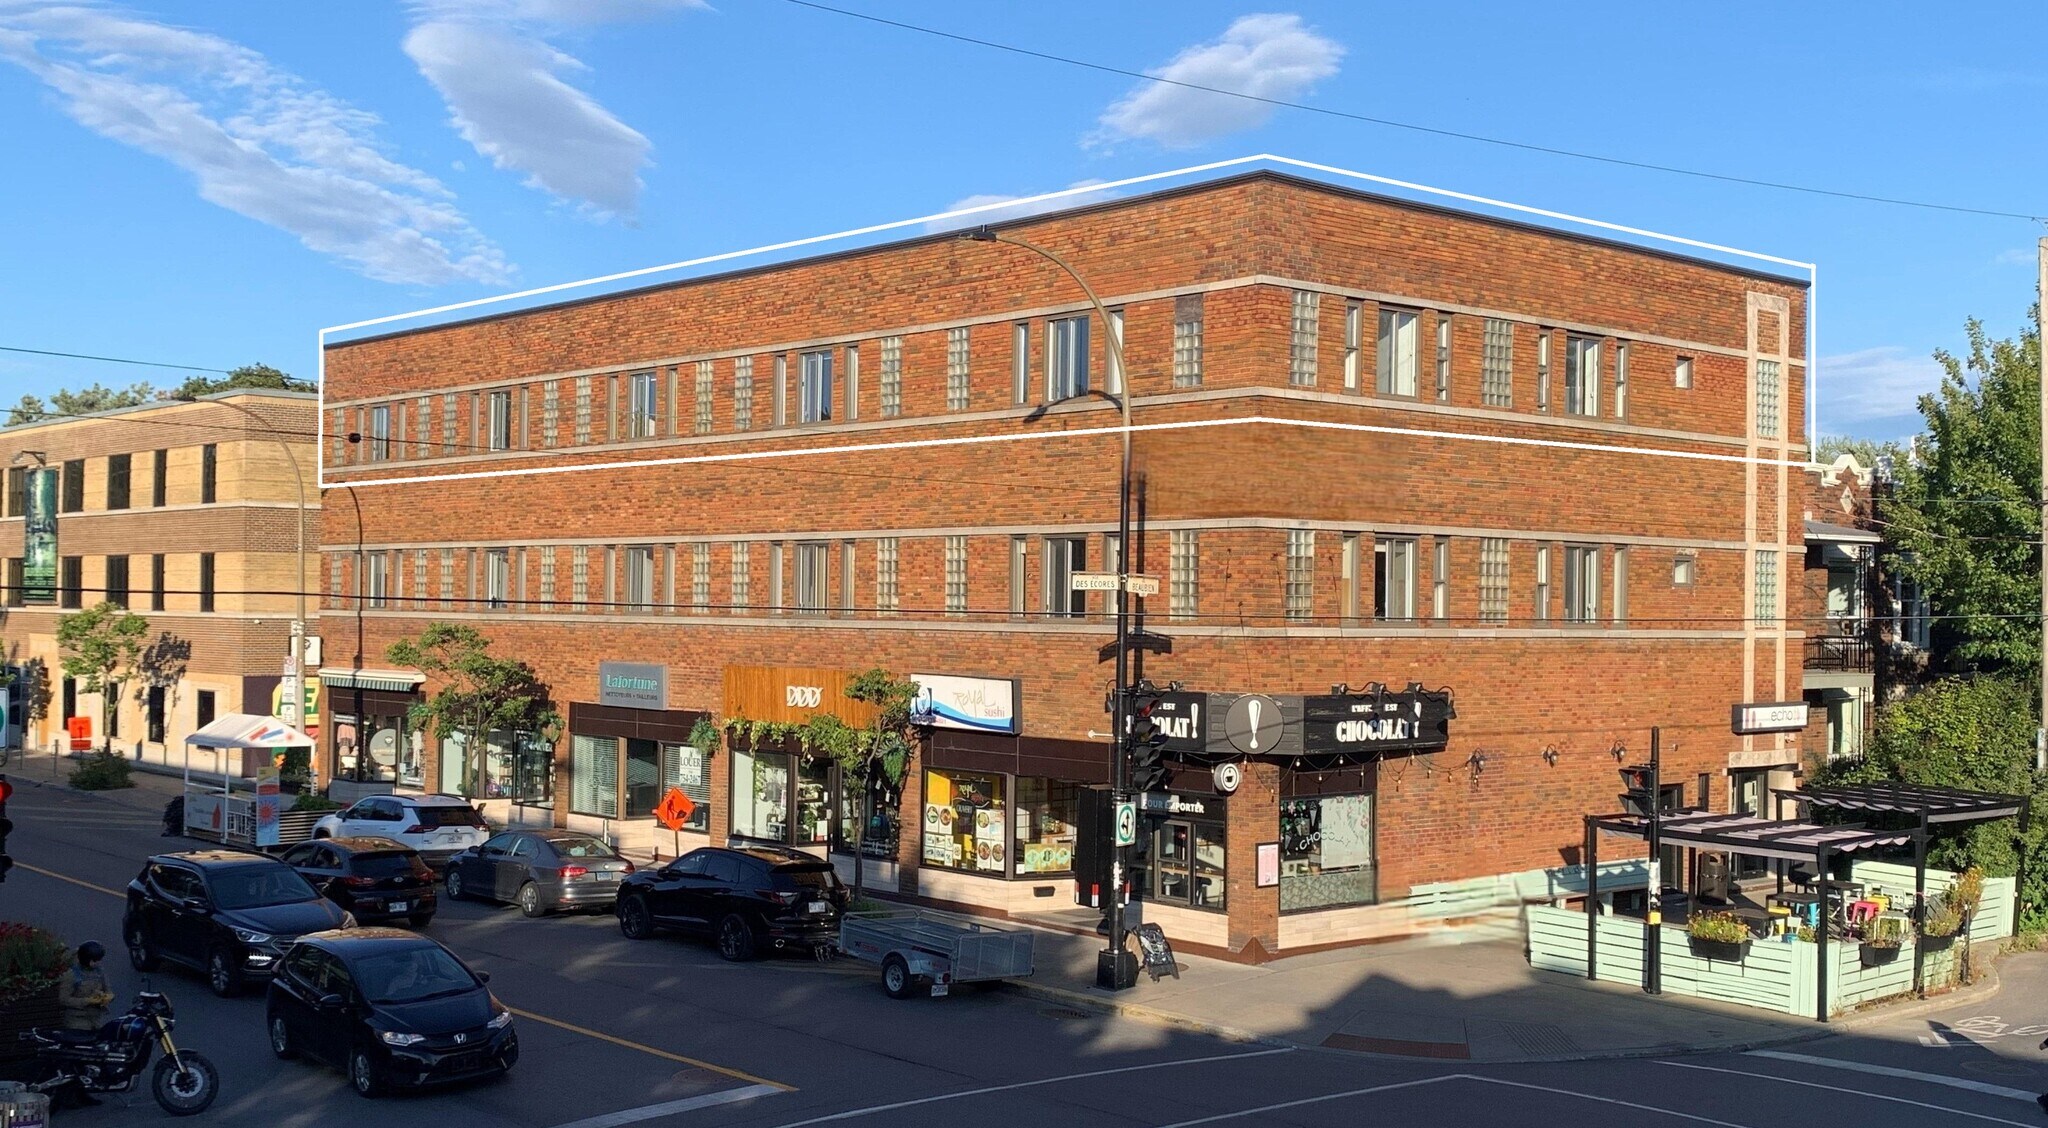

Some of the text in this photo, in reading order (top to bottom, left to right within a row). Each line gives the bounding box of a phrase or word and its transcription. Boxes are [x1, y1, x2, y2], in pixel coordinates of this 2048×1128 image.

[1075, 580, 1088, 588] DES
[1132, 583, 1155, 592] BEAUBIEN
[605, 674, 658, 691] Lafortune
[984, 705, 1005, 718] sushi
[1384, 703, 1398, 712] EST
[680, 757, 701, 767] LOUER
